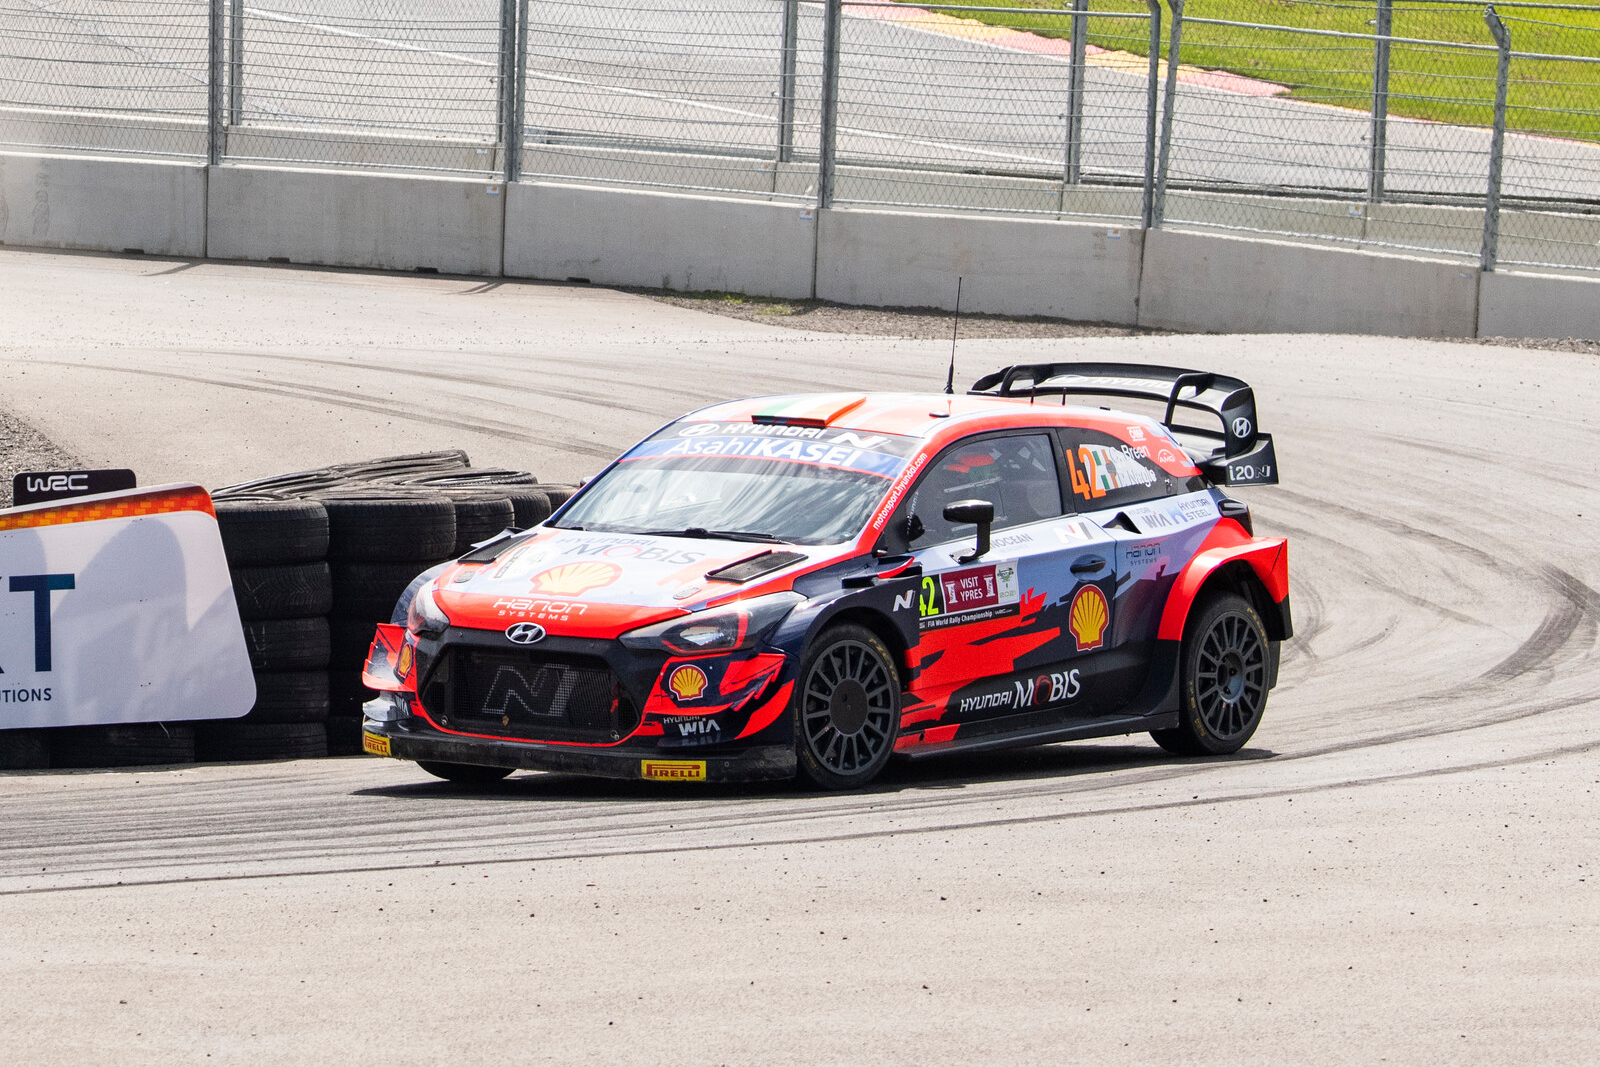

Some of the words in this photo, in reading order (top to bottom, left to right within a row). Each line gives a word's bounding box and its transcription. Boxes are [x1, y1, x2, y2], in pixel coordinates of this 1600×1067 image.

[721, 423, 828, 439] HYUNDAI
[663, 437, 864, 467] AsahiKASEI
[1121, 444, 1151, 460] Breen
[1065, 447, 1107, 501] 42
[1229, 465, 1255, 481] i20
[26, 474, 89, 492] WRC
[873, 452, 928, 530] motorsport.hyundai.com
[1178, 498, 1212, 511] HYUNDAI
[1185, 508, 1212, 521] STEEL
[555, 537, 658, 546] HYUNDAI
[562, 543, 707, 565] MOBIS
[1130, 557, 1158, 566] SYSTEMS
[960, 576, 979, 589] VISIT
[960, 588, 984, 602] YPRES
[497, 610, 569, 621] SYSTEMS
[935, 618, 949, 628] World
[949, 615, 961, 626] Rally
[961, 610, 993, 623] Championship
[960, 690, 1013, 713] HYUNDAI
[1012, 668, 1081, 710] MOBIS
[678, 717, 721, 736] WIA
[646, 763, 701, 778] PIRELLI
